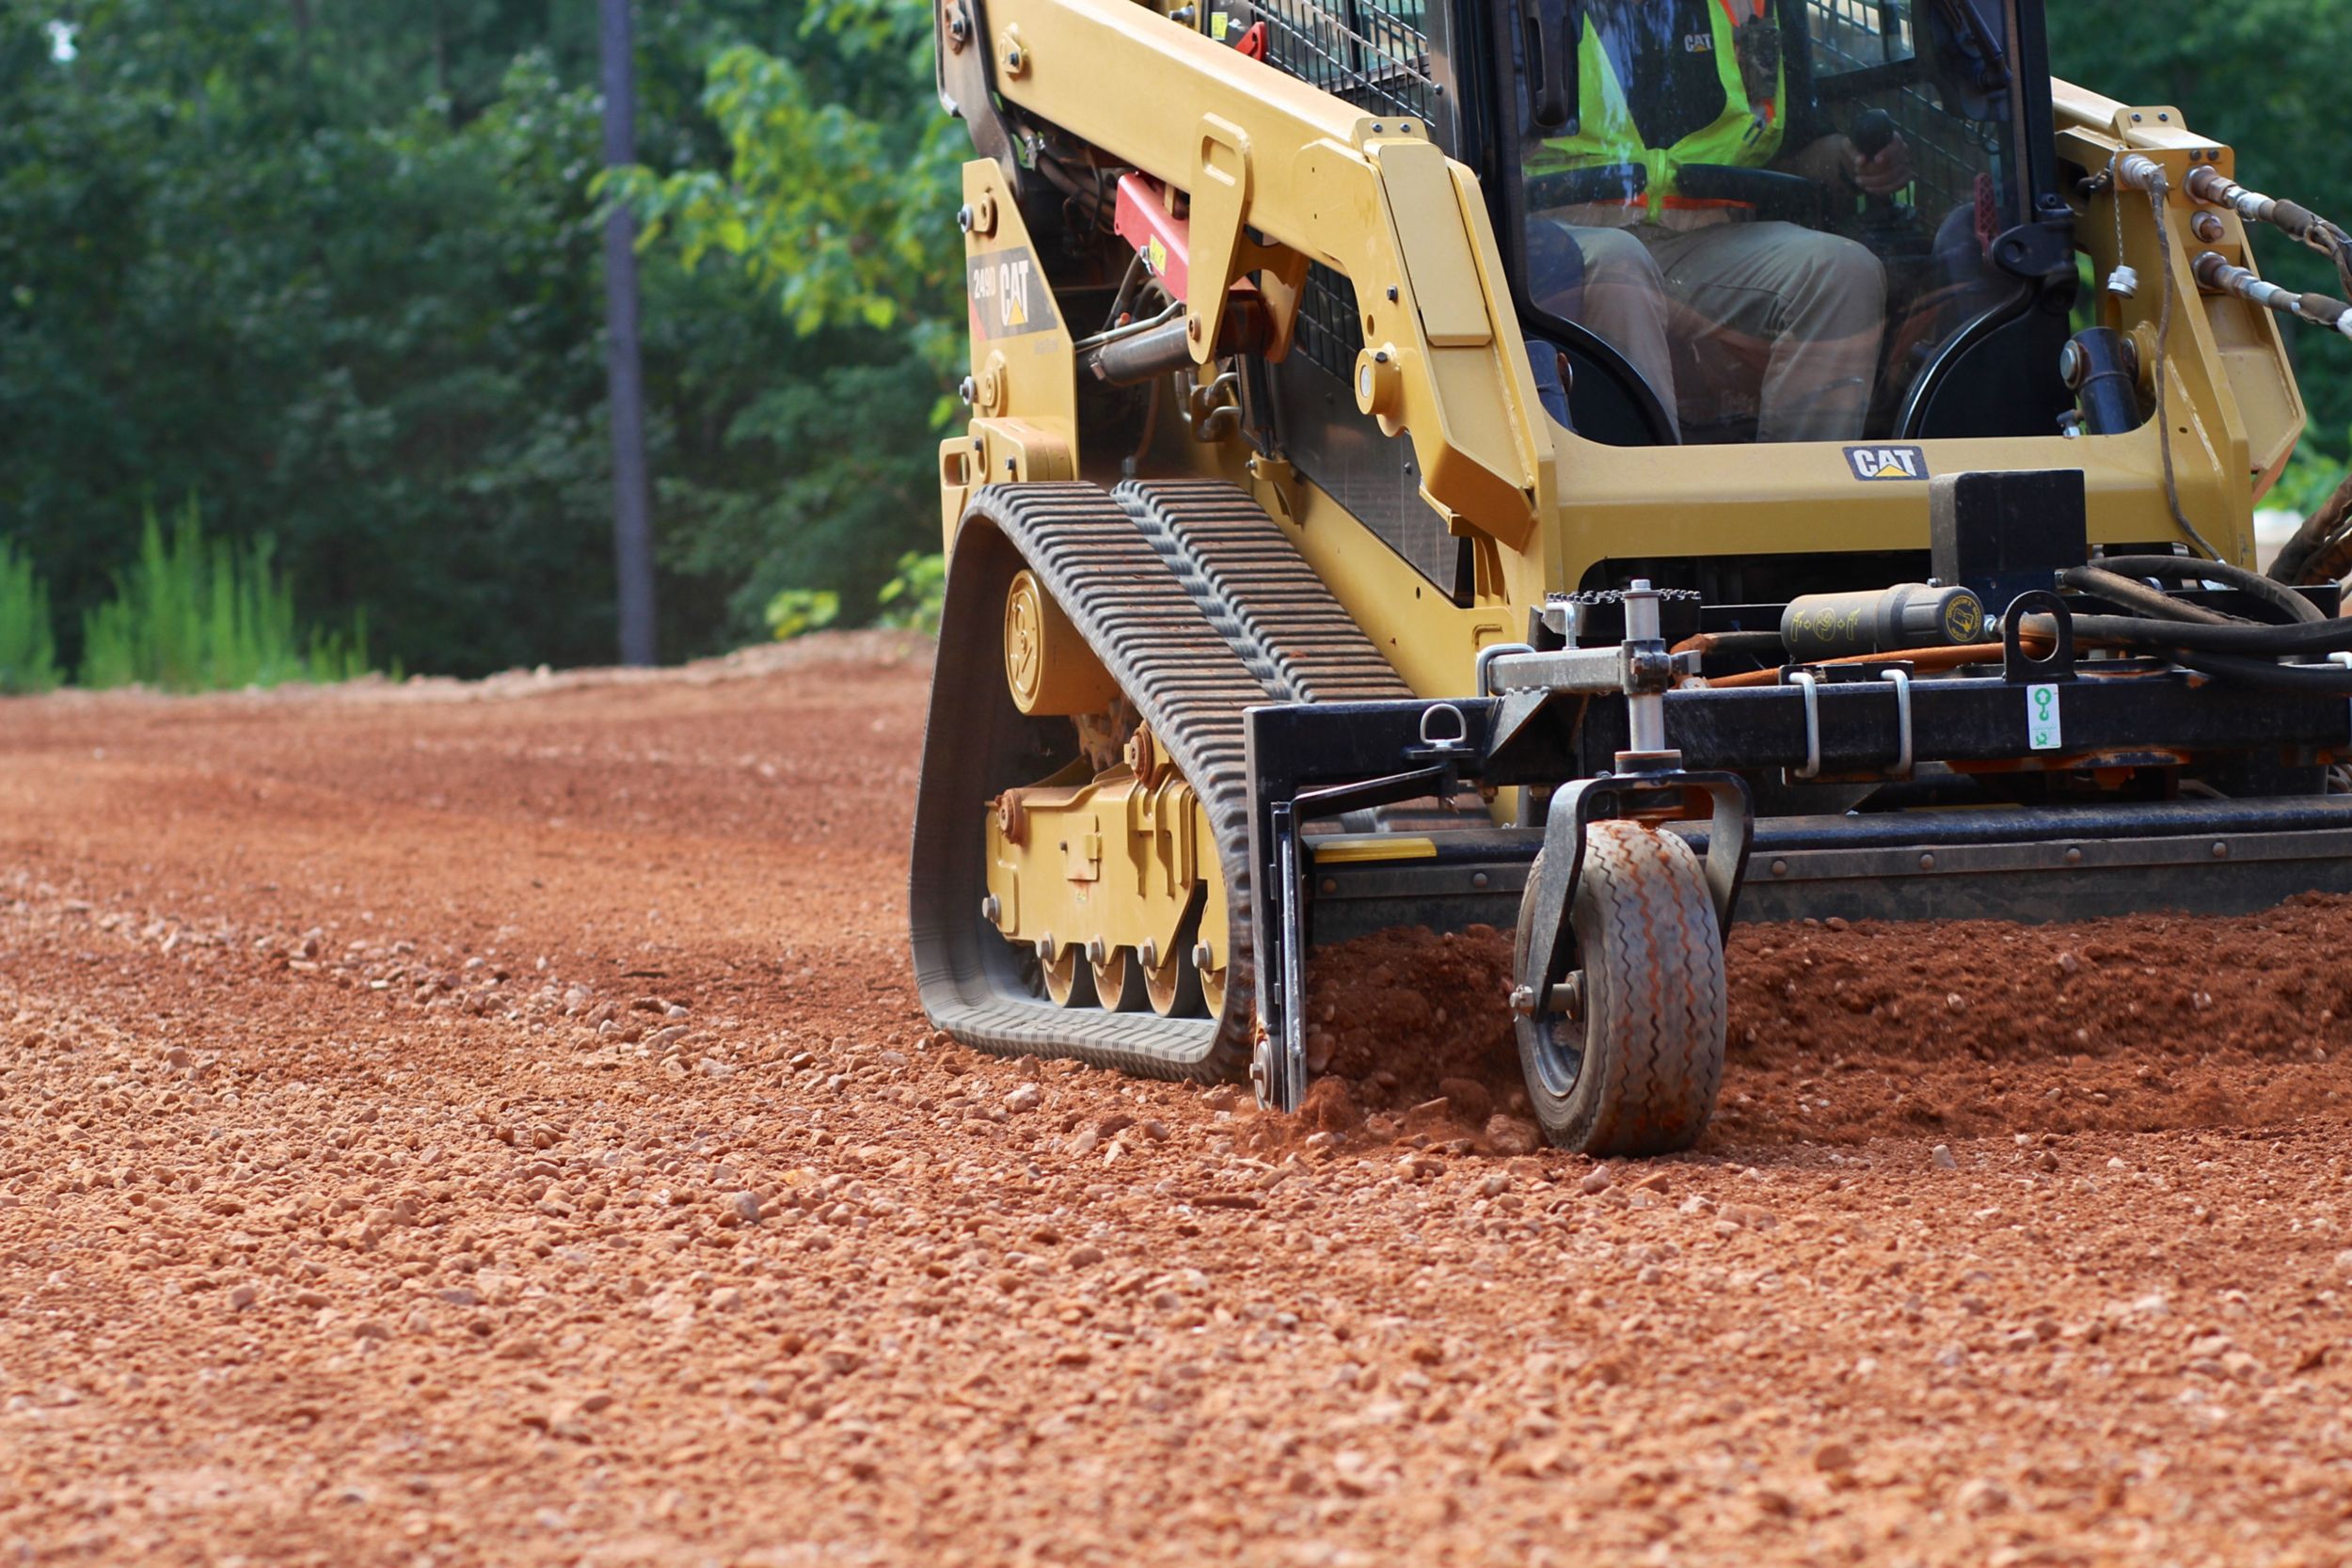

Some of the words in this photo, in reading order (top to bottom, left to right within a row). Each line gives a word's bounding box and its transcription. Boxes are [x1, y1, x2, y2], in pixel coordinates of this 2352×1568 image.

[1684, 33, 1712, 53] CAT
[999, 260, 1029, 327] CAT
[1852, 449, 1917, 478] CAT
